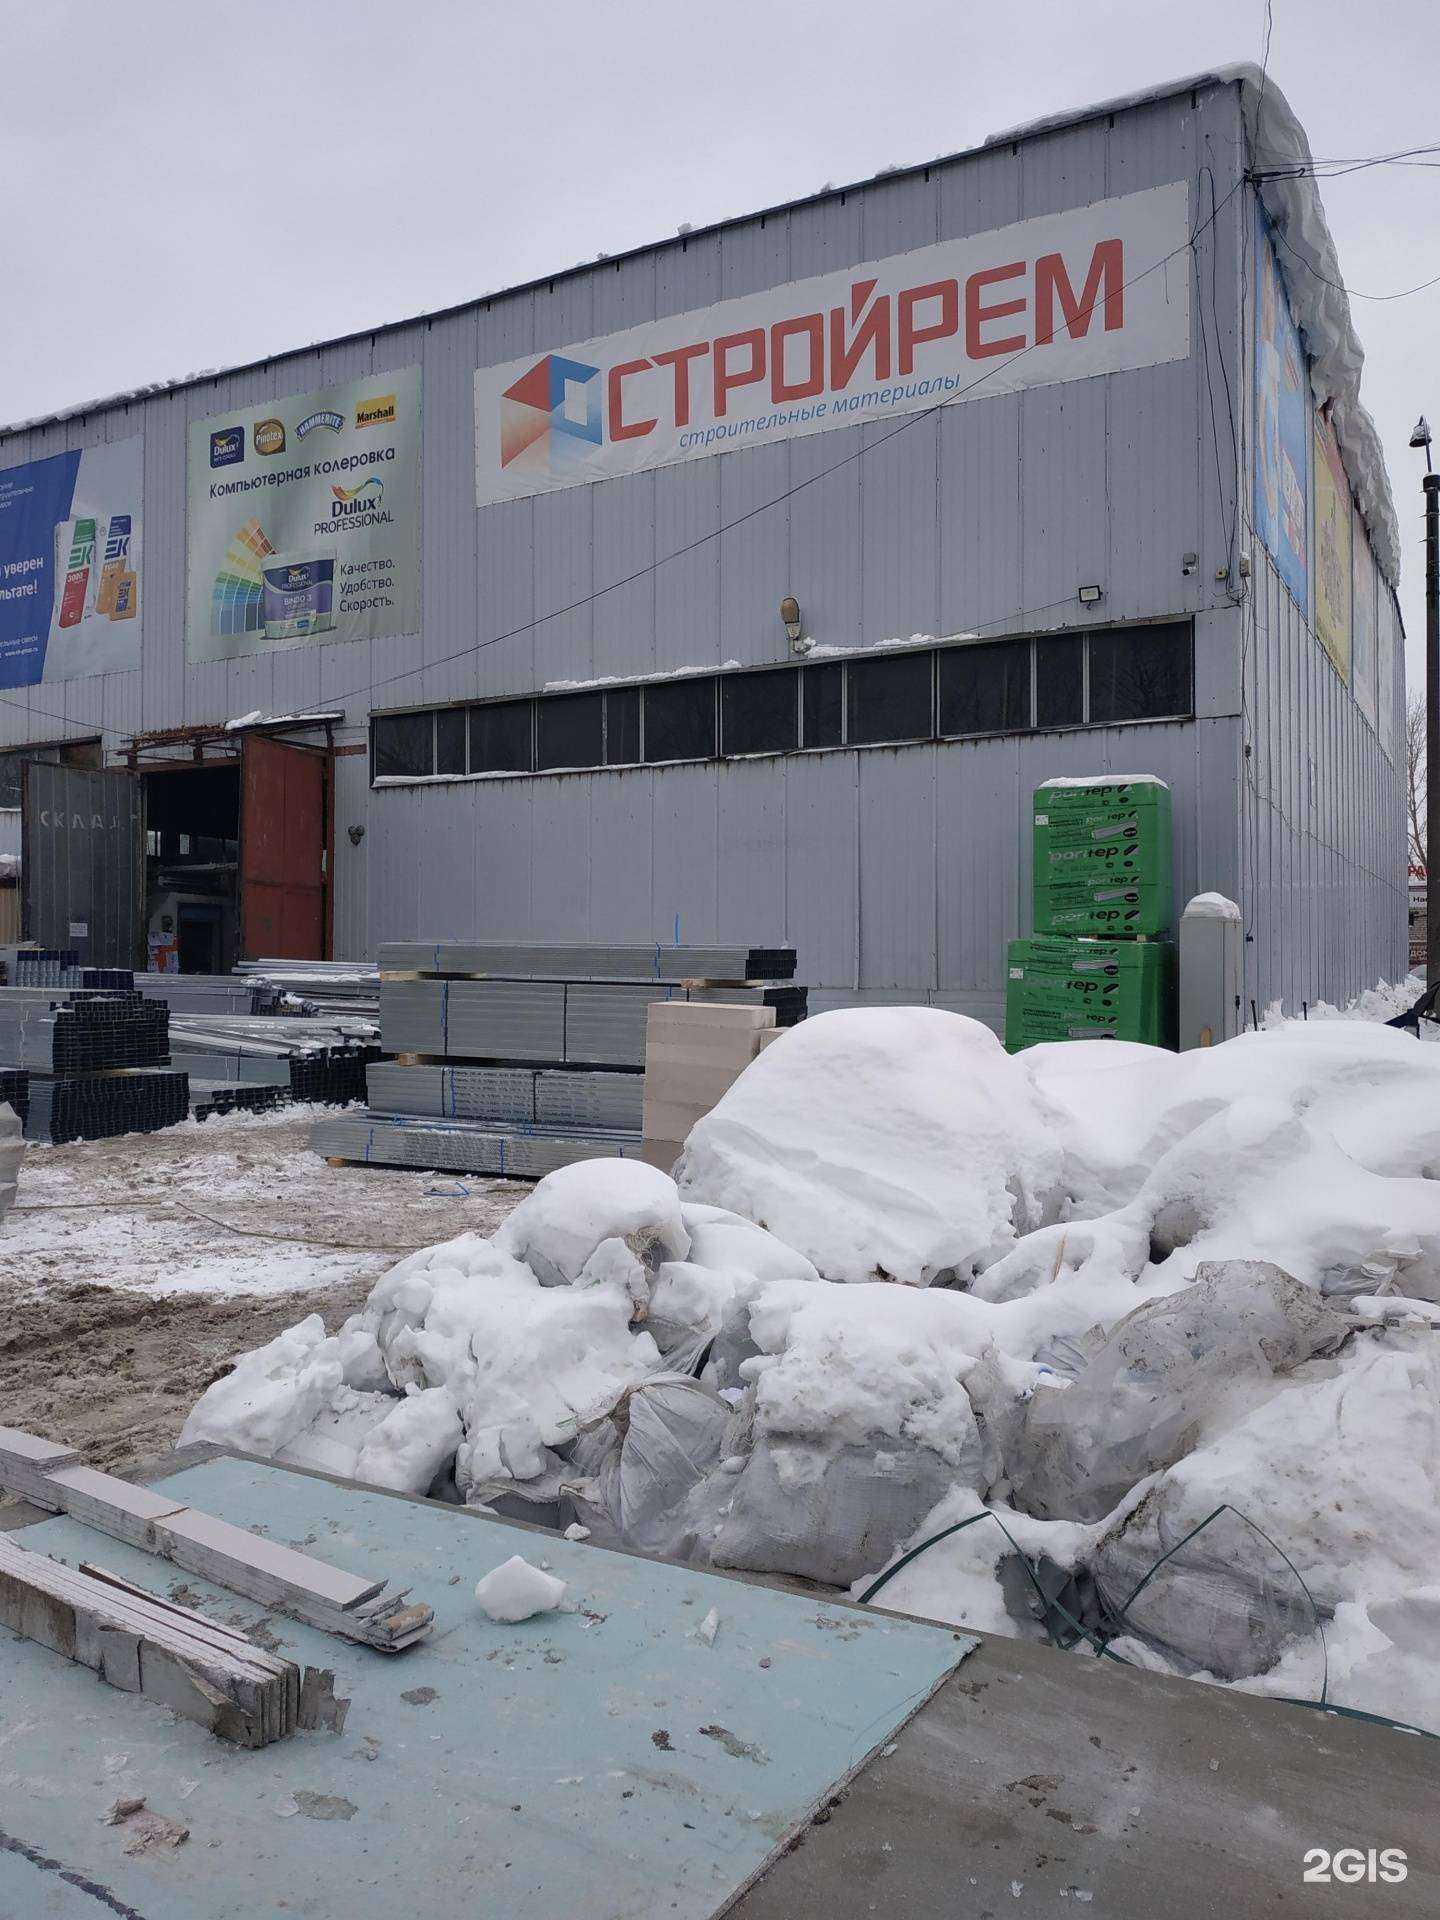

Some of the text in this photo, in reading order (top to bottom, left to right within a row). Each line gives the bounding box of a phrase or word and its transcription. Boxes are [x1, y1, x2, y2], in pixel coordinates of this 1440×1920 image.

[608, 238, 1123, 441] СТРОЙРЕМ
[356, 405, 395, 423] Marshall
[679, 373, 961, 449] строительные материалы
[298, 412, 342, 436] HAMMERITE
[213, 443, 237, 456] Dulux
[255, 431, 283, 446] Pinotex
[209, 447, 395, 499] Компьютерная колеровка
[331, 496, 378, 518] Dulux
[314, 510, 395, 536] PROFESSIONAL
[3, 556, 44, 579] уверен
[340, 558, 396, 577] Качество.
[340, 577, 395, 596] Удобство.
[339, 595, 395, 614] Скорость.
